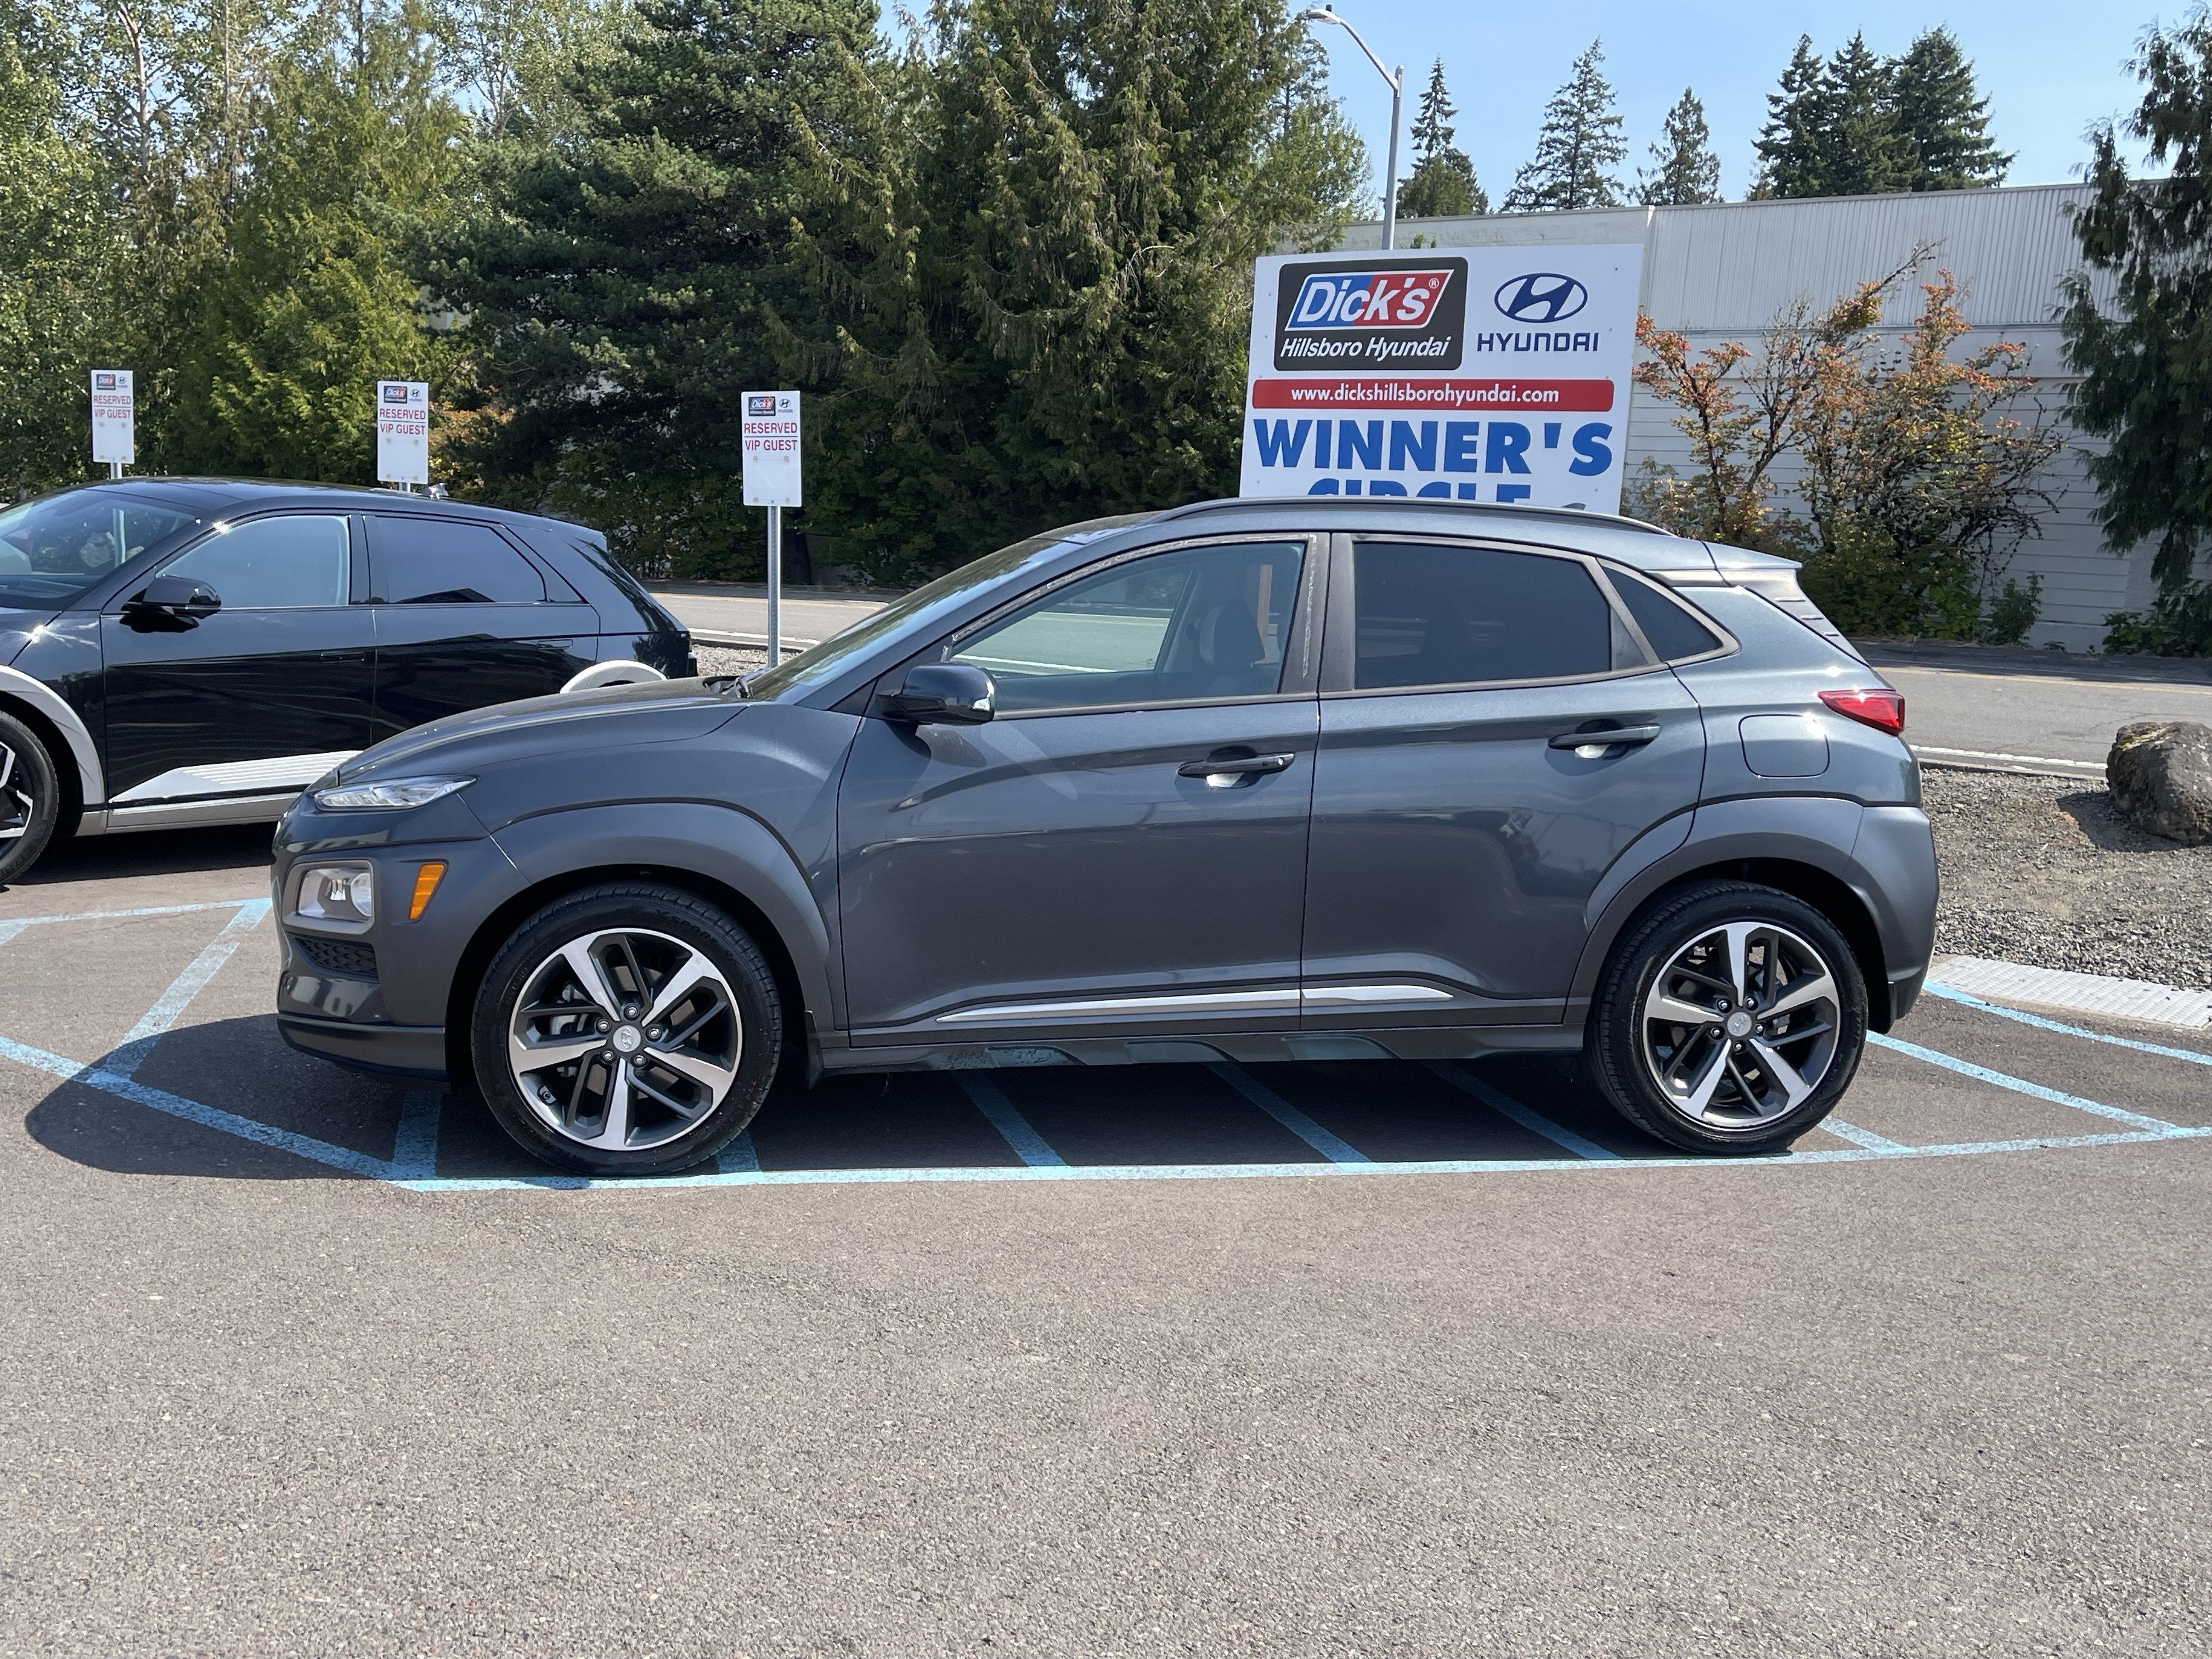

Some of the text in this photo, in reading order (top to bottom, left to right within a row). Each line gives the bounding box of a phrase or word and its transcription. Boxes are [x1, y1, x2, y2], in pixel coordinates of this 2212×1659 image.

[1477, 332, 1599, 352] HYUNDAI
[1280, 336, 1452, 362] Hillsboro Hyundai
[93, 395, 131, 404] RESERVED
[1291, 386, 1560, 407] www.dickshillsborohyundai.com
[94, 409, 131, 419] VIP GUEST
[380, 408, 426, 420] RESERVED
[380, 423, 426, 435] VIP GUEST
[744, 422, 797, 433] RESERVED
[745, 439, 798, 450] VIP GUEST
[1253, 419, 1614, 477] WINNER'S
